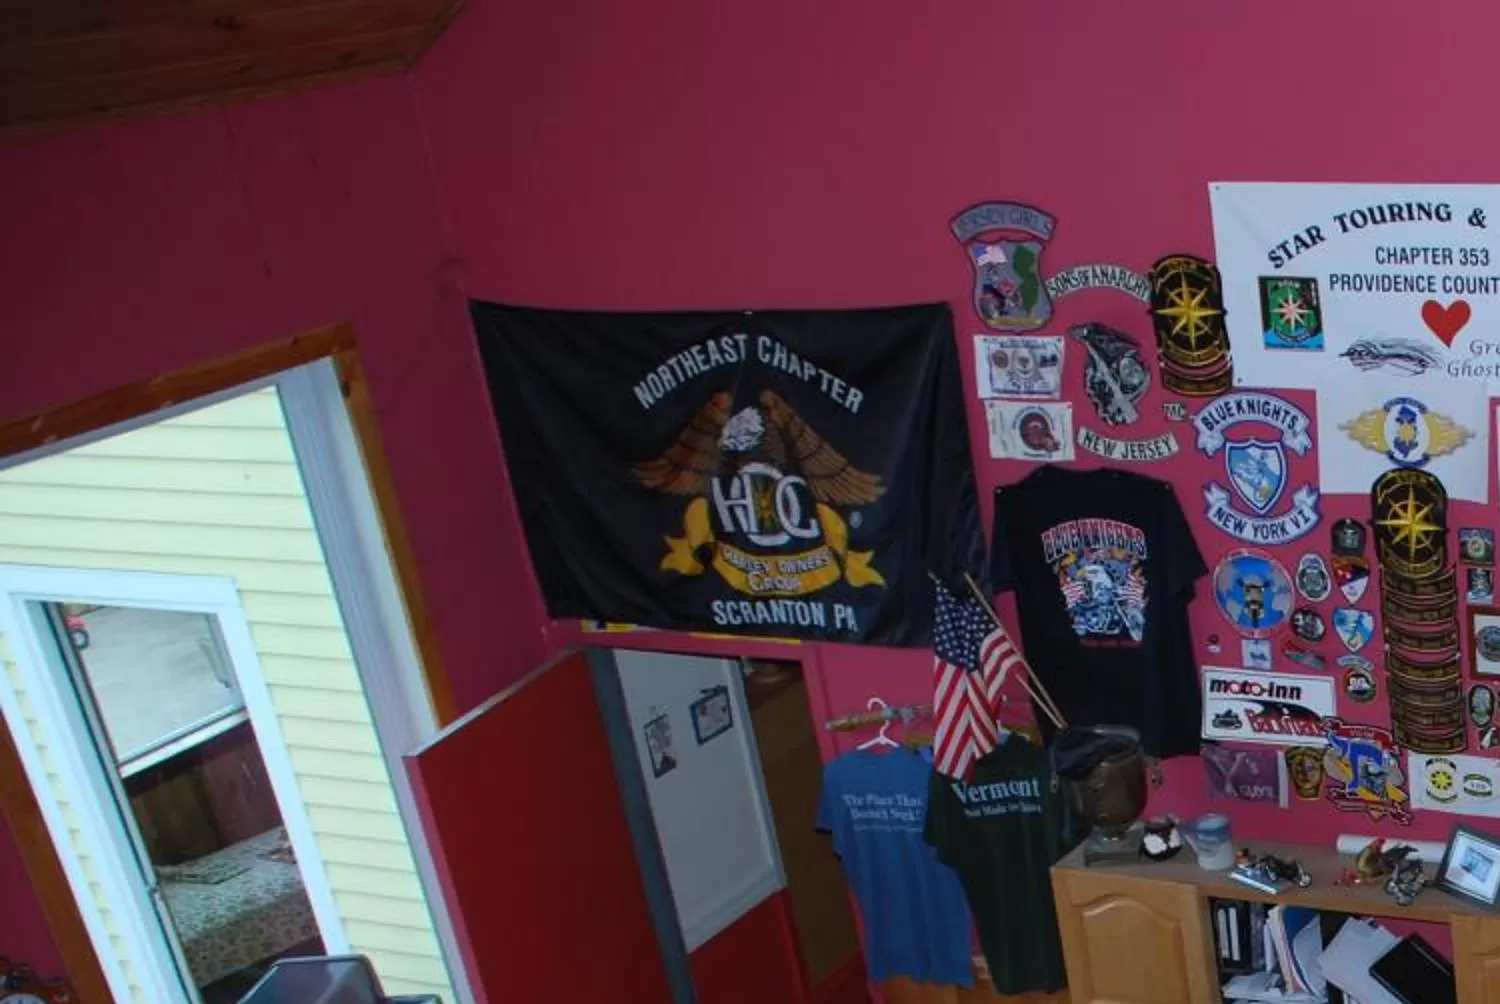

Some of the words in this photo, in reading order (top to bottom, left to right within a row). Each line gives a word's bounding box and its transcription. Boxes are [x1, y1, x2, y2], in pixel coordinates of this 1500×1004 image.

[1267, 225, 1326, 270] STAR
[1333, 202, 1453, 234] TOURING
[1468, 207, 1489, 229] &
[1375, 246, 1454, 268] CHAPTER
[1458, 247, 1490, 268] 353
[1329, 273, 1437, 294] PROVIDENCE
[633, 333, 750, 410] NORTHEAST
[757, 335, 864, 414] CHAPTER
[1082, 431, 1117, 457] NEW
[1120, 435, 1177, 459] JERSEY
[1213, 506, 1248, 535] NEW
[1252, 519, 1290, 541] YORK
[712, 599, 824, 628] SCRANTON
[833, 602, 859, 632] PA
[1209, 678, 1303, 701] moto-inn
[950, 776, 1041, 804] Vermont
